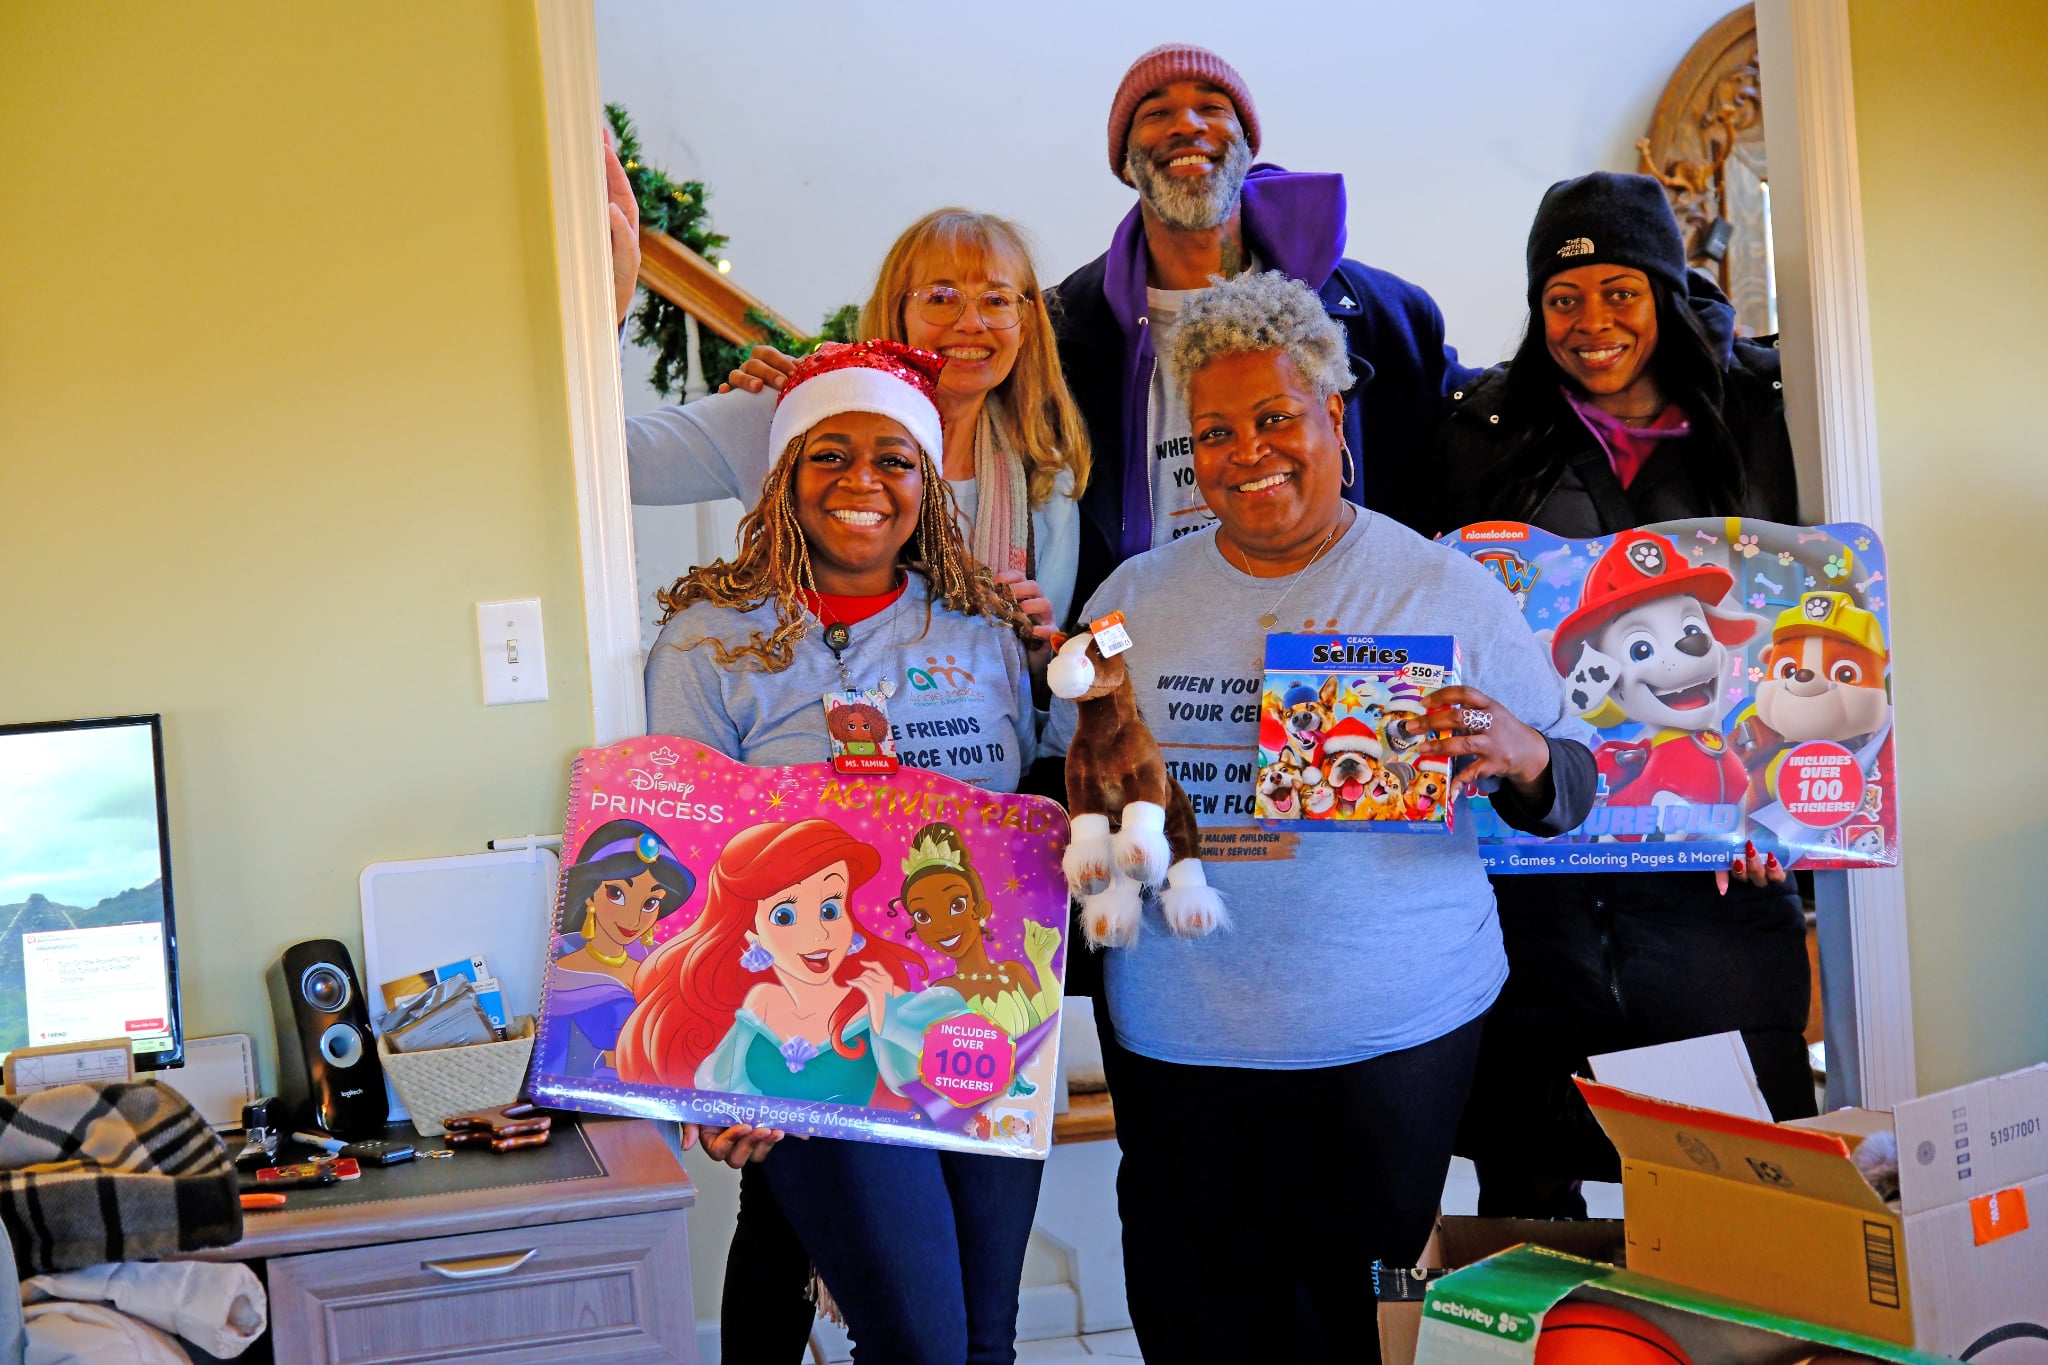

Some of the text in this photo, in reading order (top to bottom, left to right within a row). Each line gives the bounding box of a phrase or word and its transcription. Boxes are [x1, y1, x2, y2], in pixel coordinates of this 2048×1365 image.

[1465, 529, 1524, 540] nickelodeon
[1483, 558, 1541, 593] AW
[1312, 644, 1409, 665] Selfies
[1411, 666, 1433, 678] 550
[1157, 674, 1260, 695] WHEN YOU
[1168, 701, 1224, 722] YOUR
[905, 716, 981, 741] FRIENDS
[845, 760, 890, 768] MS. TAMIKA
[896, 743, 1006, 768] ORCE YOU TO
[1788, 755, 1852, 767] INCLUDES
[1224, 763, 1252, 784] ON
[1800, 766, 1841, 779] OVER
[628, 768, 695, 801] Disney
[1797, 779, 1844, 801] 100
[591, 792, 724, 824] PRINCESS
[819, 779, 1050, 835] ACTIVITY PAD
[1788, 801, 1856, 813] STICKERS!
[1663, 803, 1741, 835] PAD
[1205, 833, 1237, 843] MALONE
[1240, 832, 1280, 843] CHILDREN
[1227, 846, 1267, 857] SERVICES
[1509, 854, 1556, 867] Games
[1569, 852, 1628, 868] Coloring
[1631, 852, 1675, 866] Pages
[1678, 851, 1688, 864] &
[1690, 850, 1730, 864] More!
[941, 1024, 998, 1040] INCLUDES
[952, 1038, 984, 1051] OVER
[935, 1048, 996, 1079] 100
[341, 1087, 364, 1099] logitech
[934, 1076, 994, 1093] STICKERS!
[691, 1098, 755, 1121] Coloring
[759, 1105, 806, 1124] Pages
[808, 1110, 821, 1124] &
[1989, 1116, 2041, 1148] 51977001
[1431, 1299, 1495, 1328] activity
